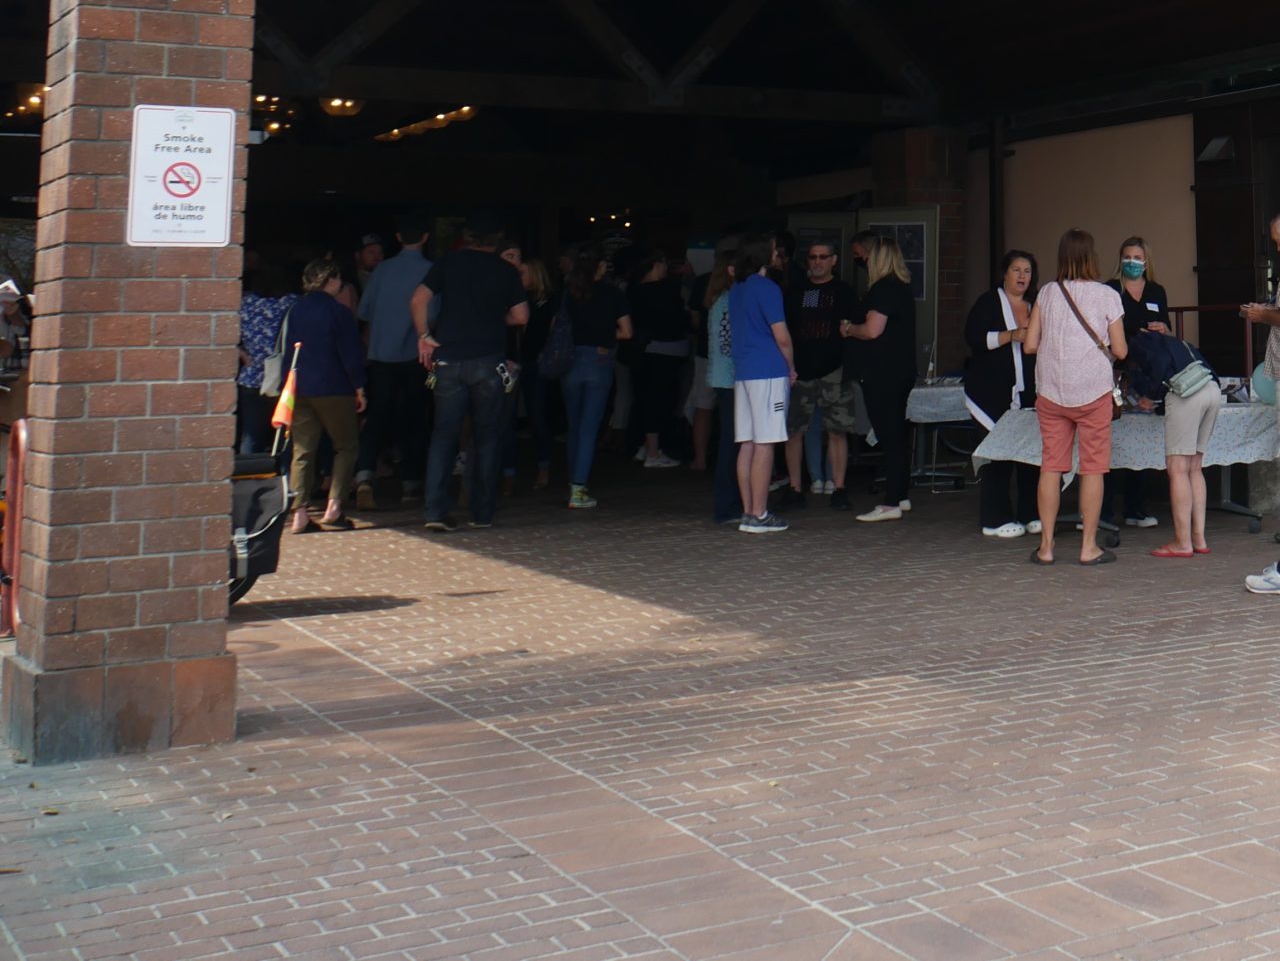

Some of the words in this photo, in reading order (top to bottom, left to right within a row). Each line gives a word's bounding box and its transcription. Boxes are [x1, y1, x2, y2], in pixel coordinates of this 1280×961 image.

[164, 133, 204, 143] Smoke
[154, 144, 180, 153] Free
[184, 145, 212, 154] Area
[152, 203, 177, 211] área
[180, 204, 206, 212] libre
[172, 213, 204, 221] humo
